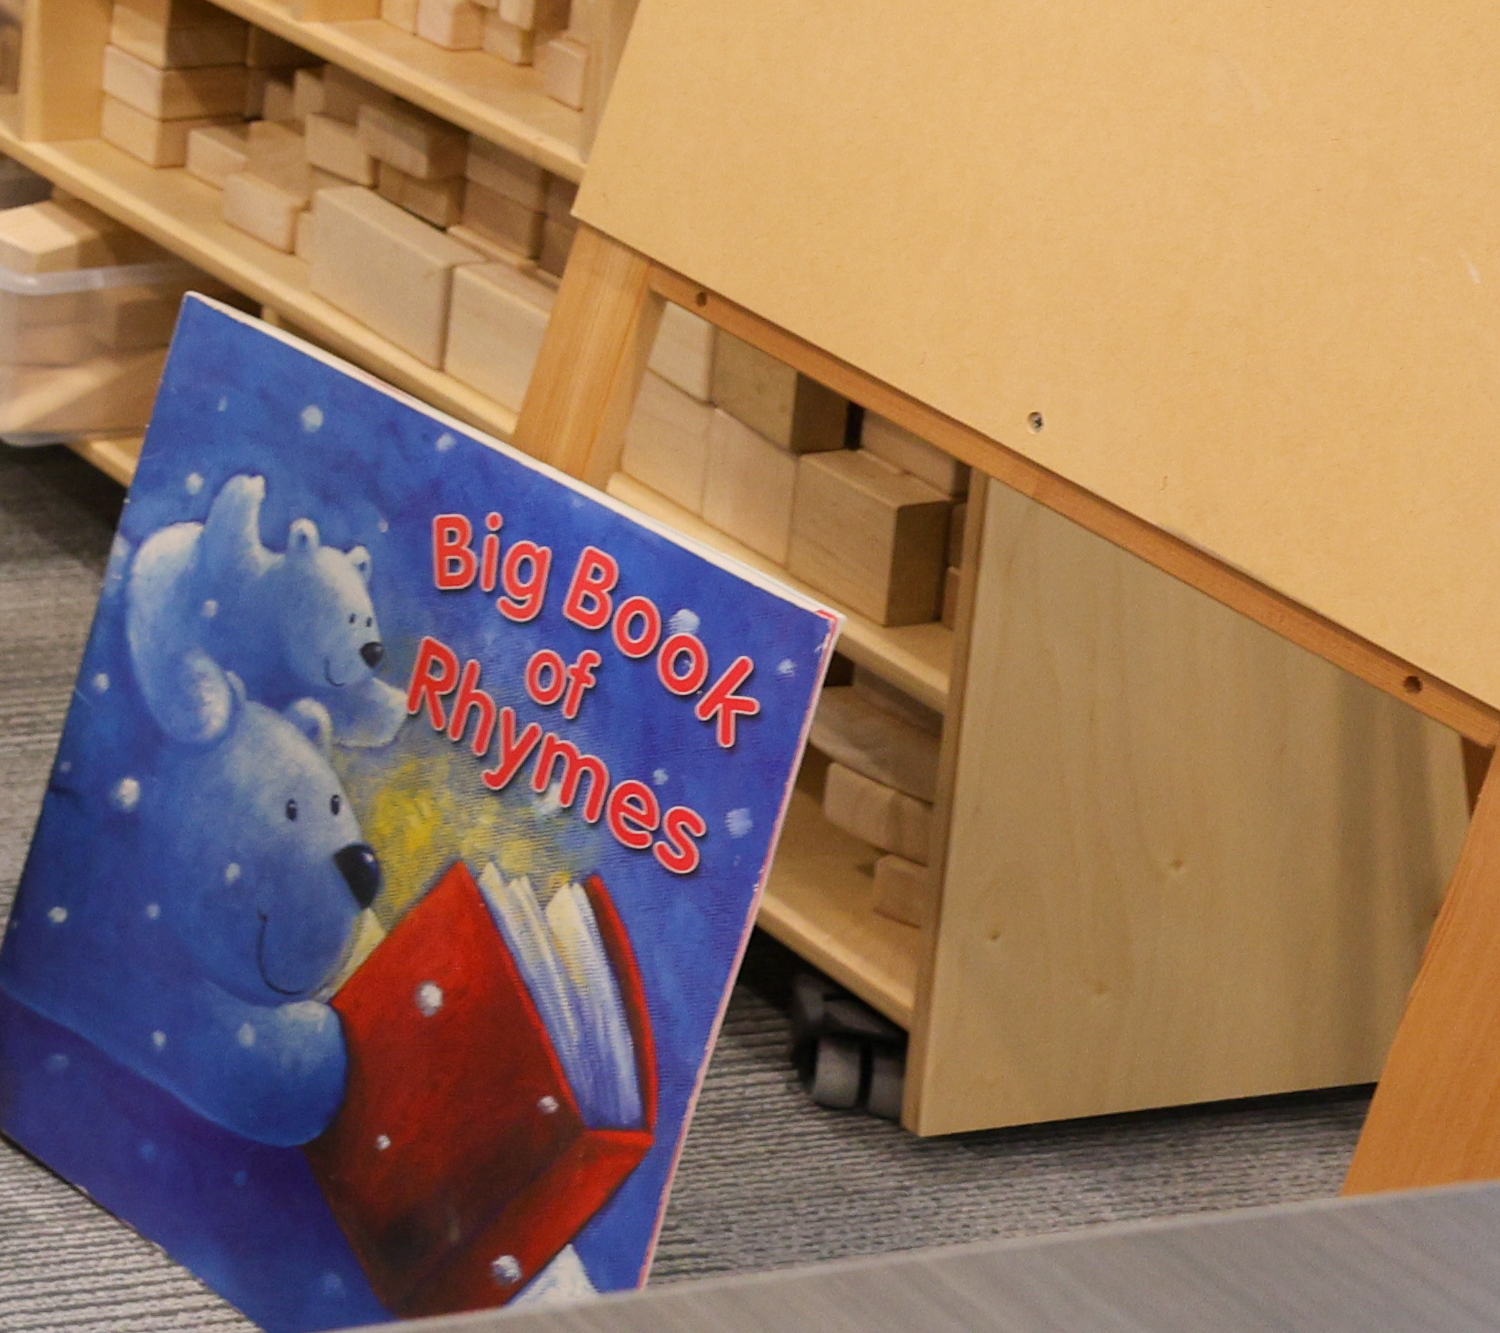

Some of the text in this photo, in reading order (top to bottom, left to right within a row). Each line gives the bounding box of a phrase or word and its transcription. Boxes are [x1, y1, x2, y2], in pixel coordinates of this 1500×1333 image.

[432, 511, 761, 749] Big Book
[524, 648, 602, 720] of
[406, 635, 707, 875] Rhymes
